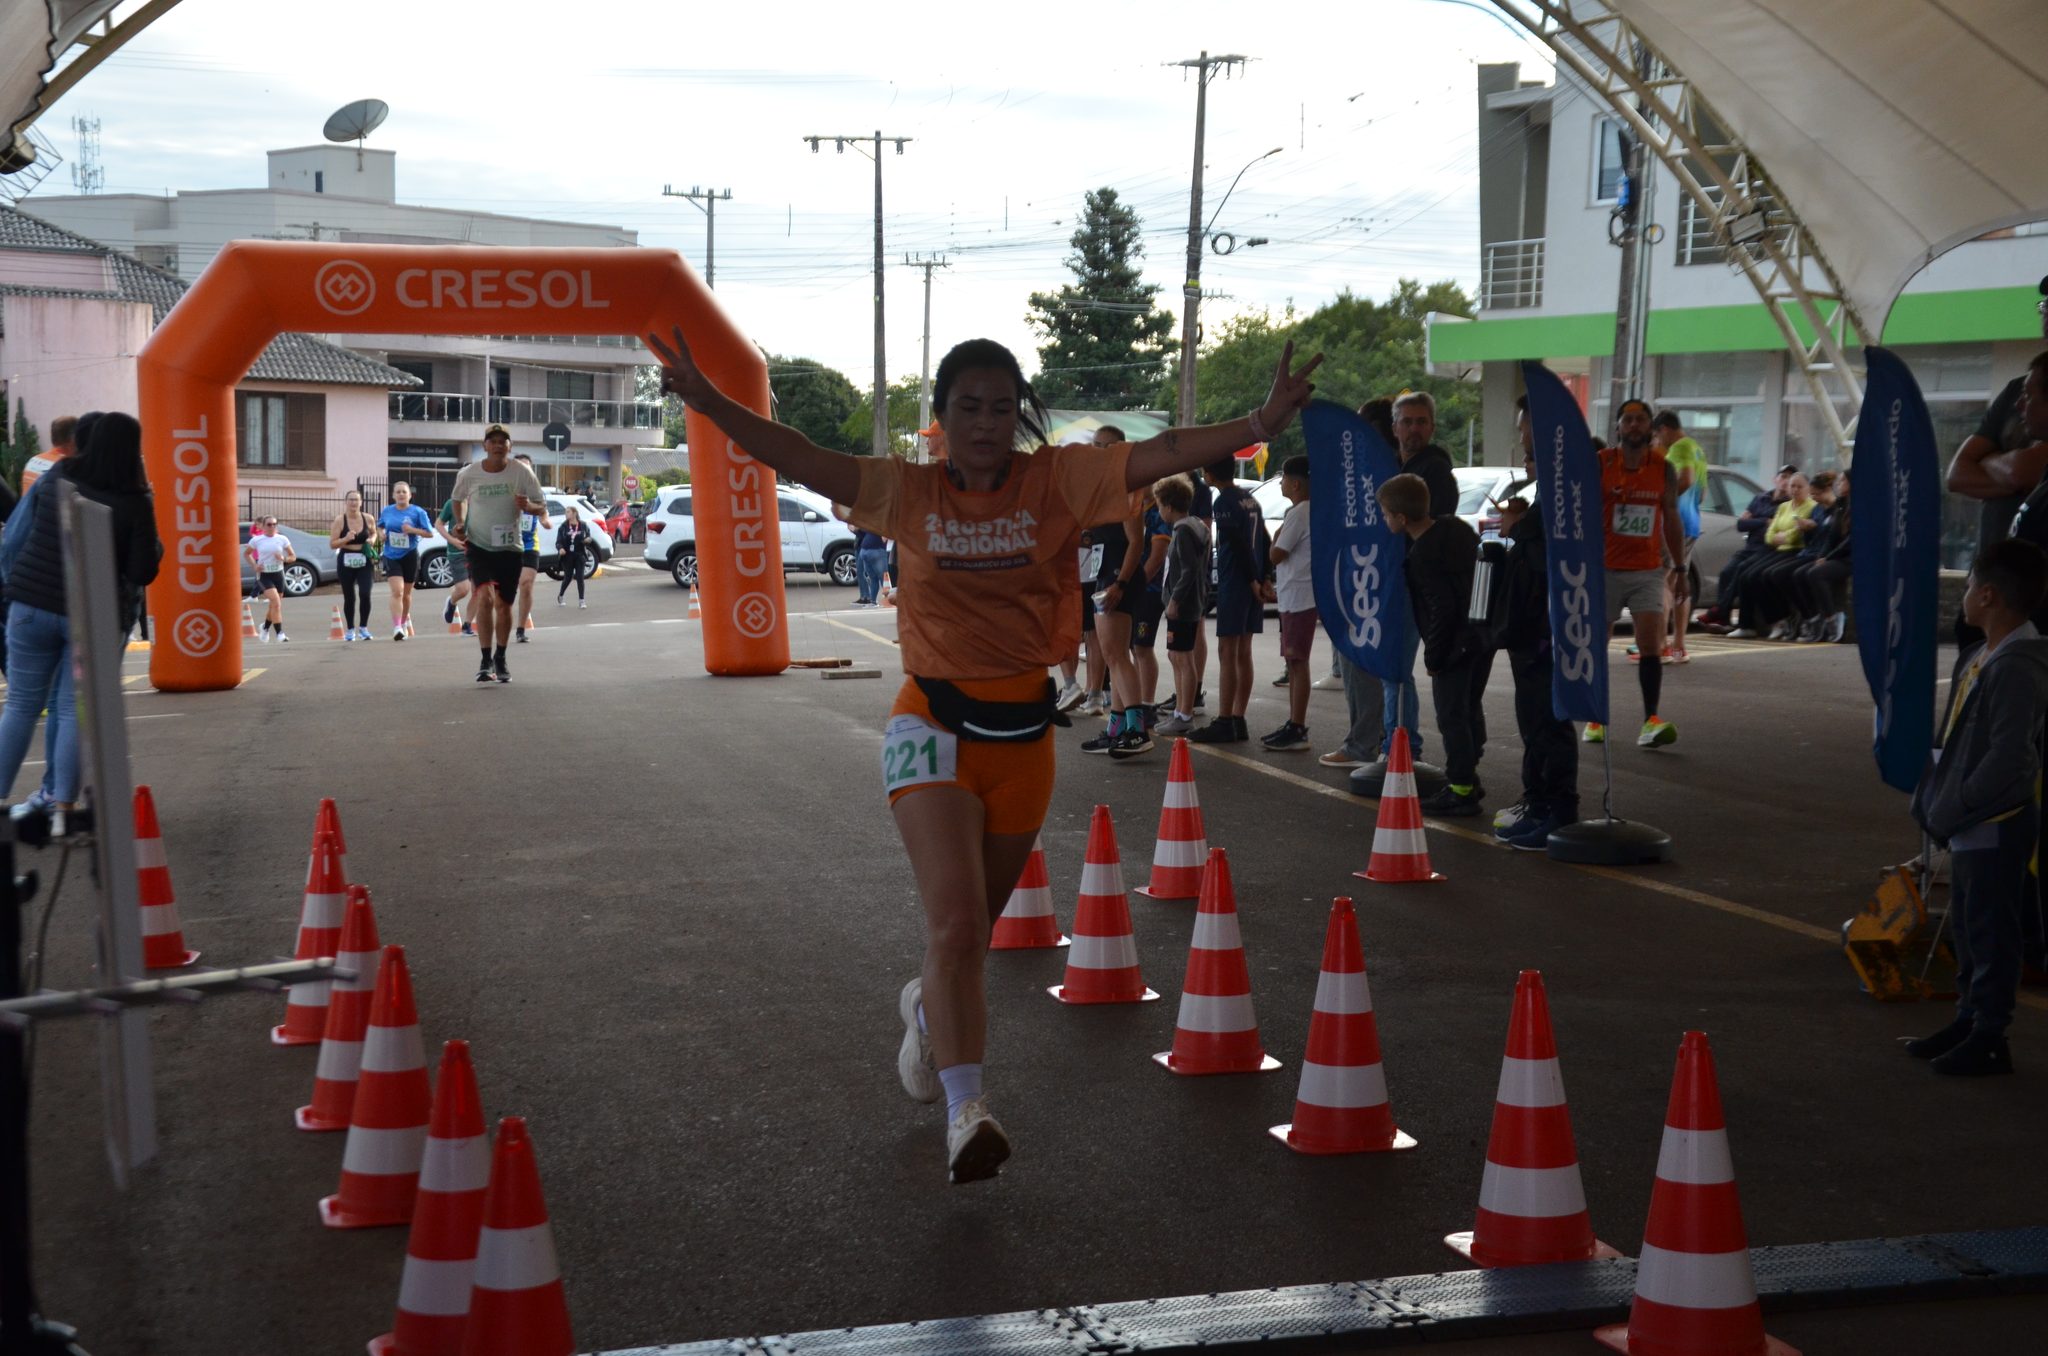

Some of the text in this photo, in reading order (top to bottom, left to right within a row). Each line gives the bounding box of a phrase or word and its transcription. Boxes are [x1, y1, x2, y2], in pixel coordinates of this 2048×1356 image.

[395, 268, 611, 309] CRESOL
[1339, 429, 1358, 529] Fecomércio
[1552, 424, 1569, 540] Fecomércio
[171, 413, 215, 595] CRESOL
[500, 531, 515, 545] 15
[927, 530, 1038, 556] REGIONAL
[1249, 511, 1258, 549] 7
[1617, 516, 1650, 534] 248
[884, 734, 938, 786] 221
